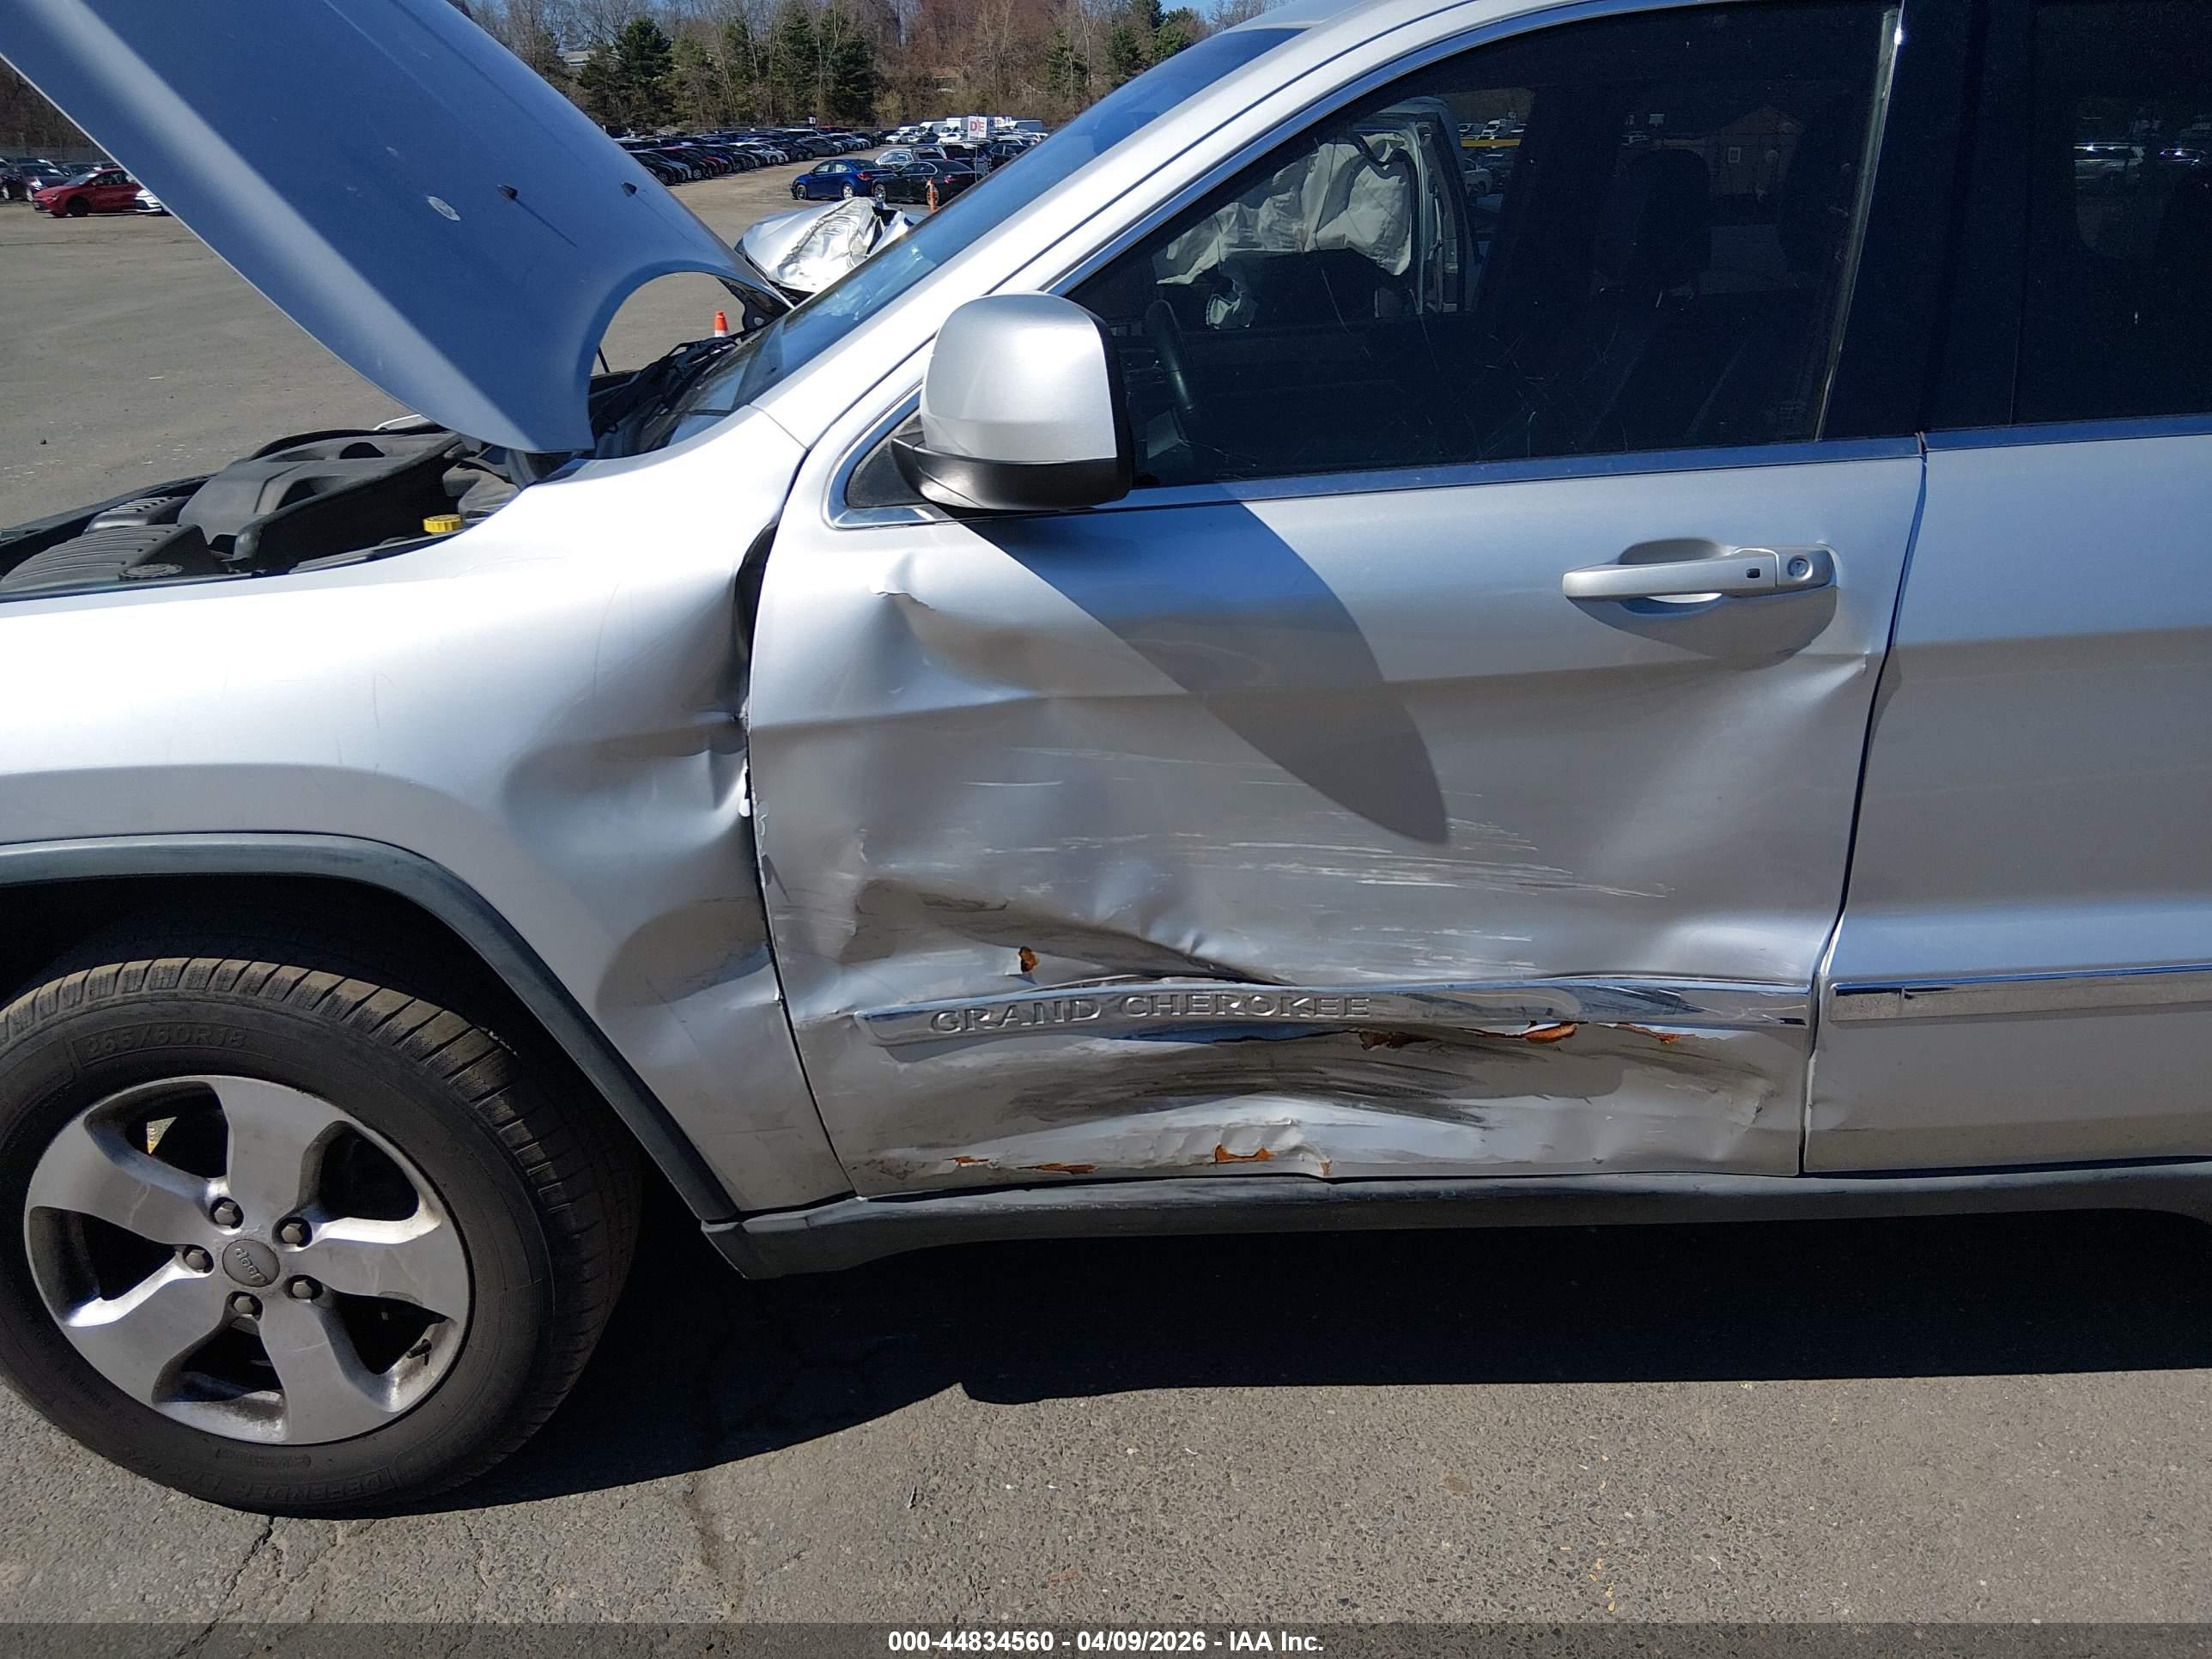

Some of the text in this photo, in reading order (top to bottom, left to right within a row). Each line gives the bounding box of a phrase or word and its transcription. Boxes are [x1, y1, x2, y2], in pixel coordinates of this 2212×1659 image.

[969, 120, 985, 132] DE
[931, 994, 1371, 1034] GRAND CHEROKEE
[234, 1248, 268, 1282] Jeep
